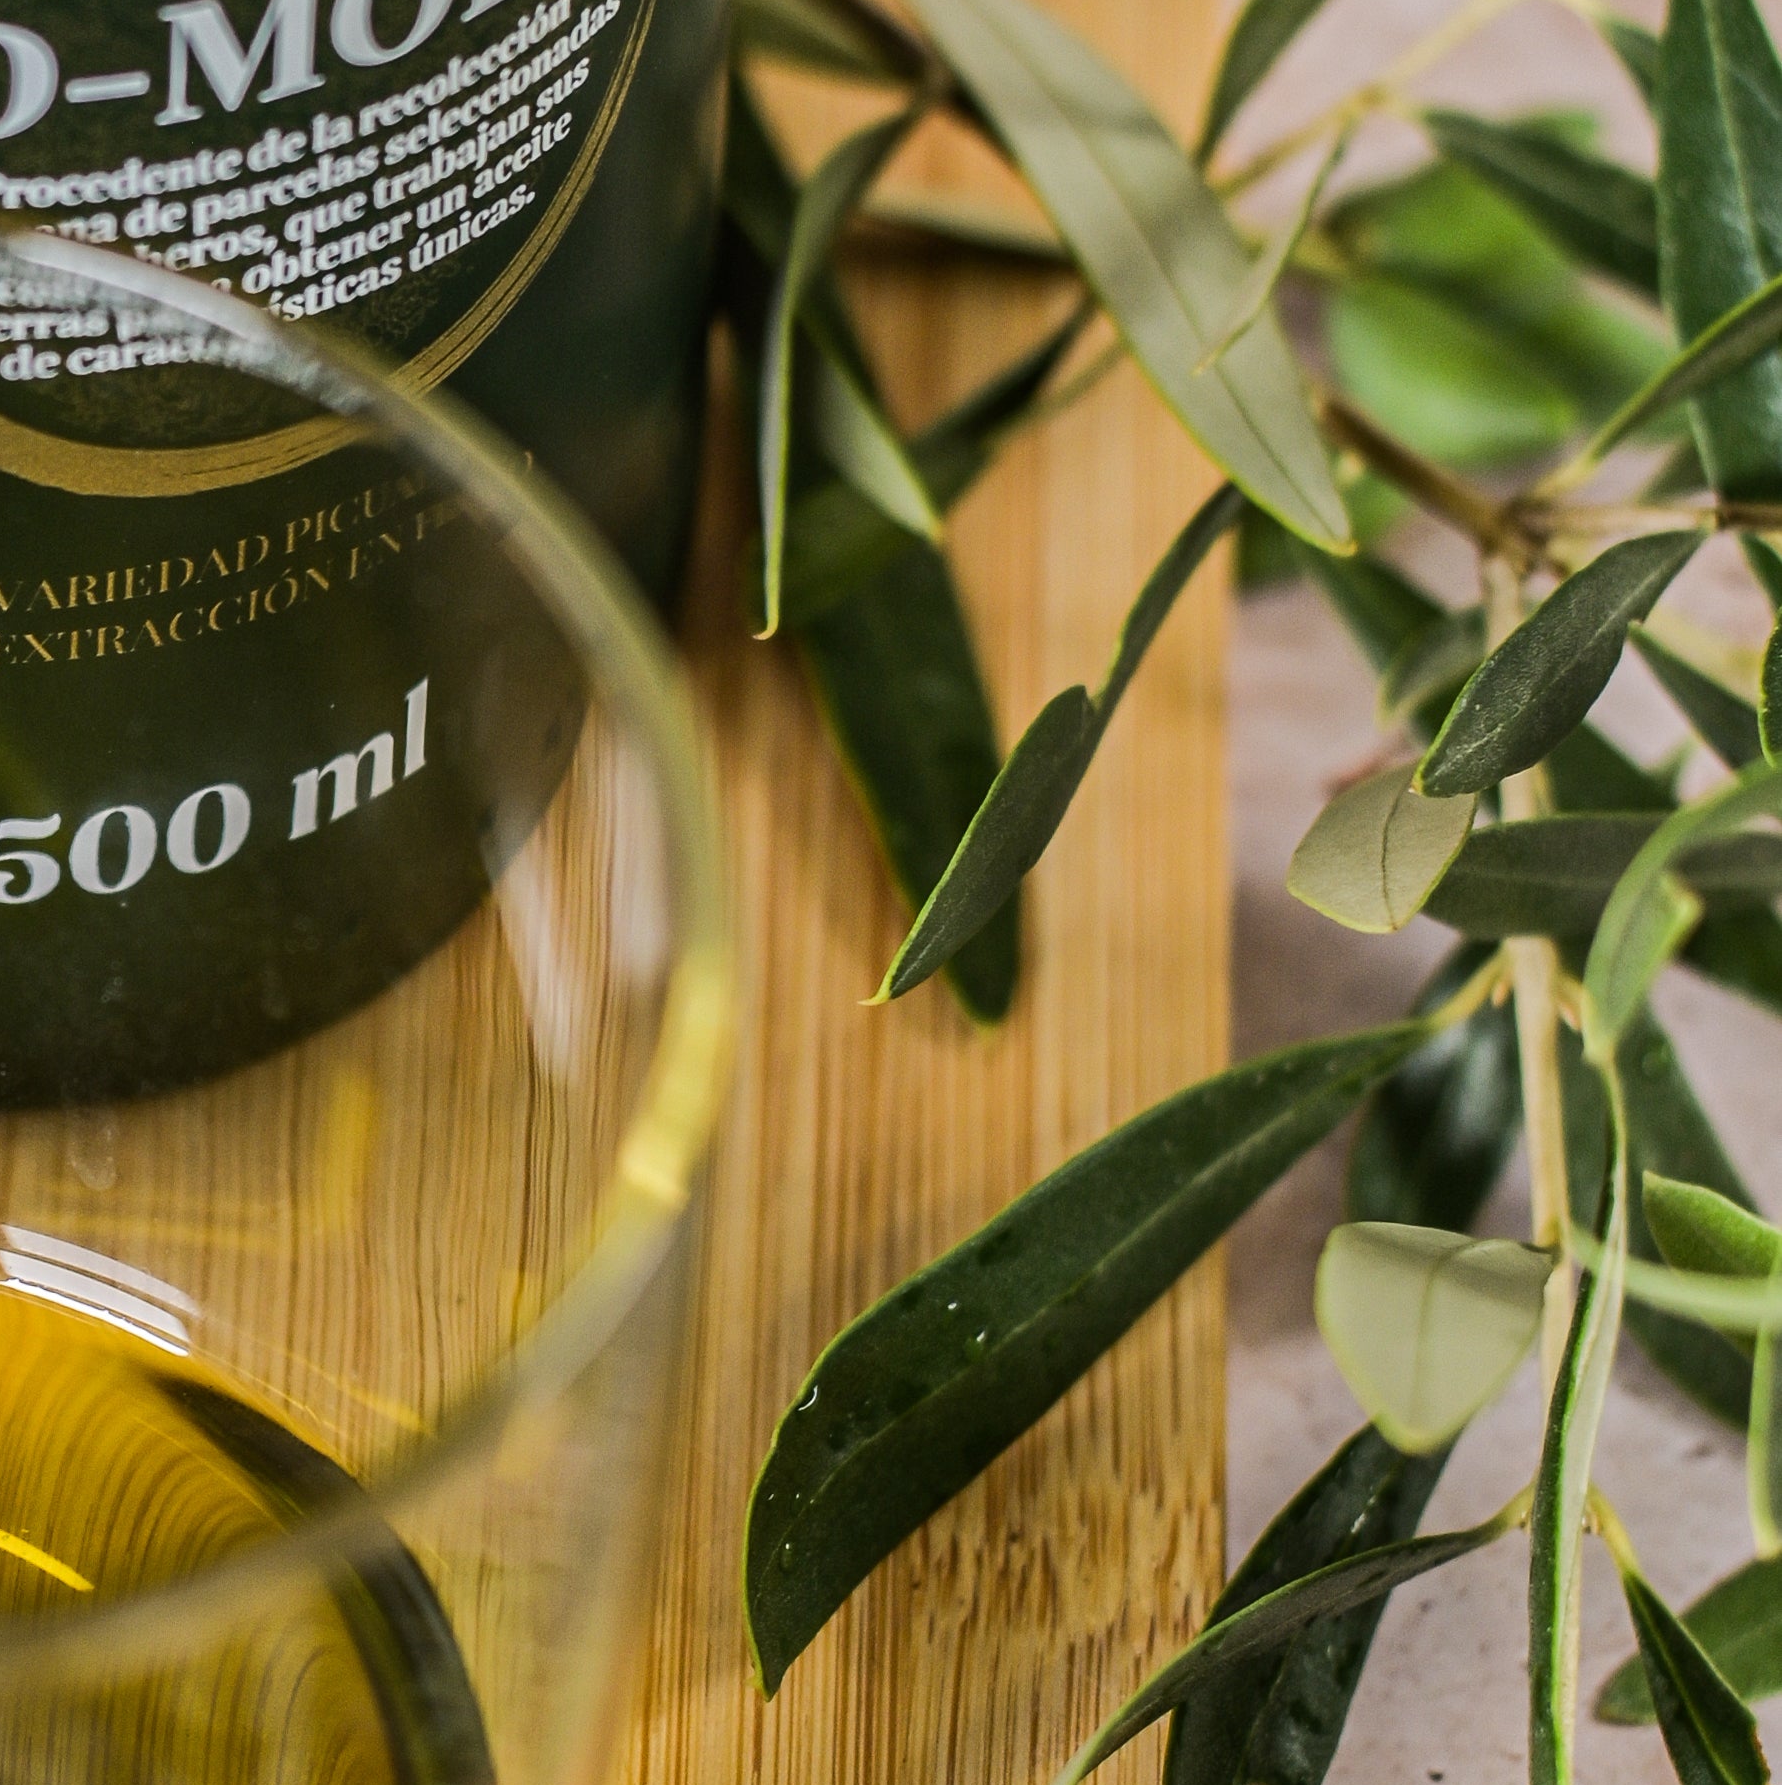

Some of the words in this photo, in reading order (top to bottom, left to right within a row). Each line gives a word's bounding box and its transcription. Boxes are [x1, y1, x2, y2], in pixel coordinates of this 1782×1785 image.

[123, 196, 187, 239] de
[191, 144, 380, 237] parcelas
[241, 209, 414, 294] obtener
[416, 183, 468, 229] un
[472, 111, 573, 198] aceite
[246, 127, 307, 172] de
[311, 112, 354, 154] la
[283, 190, 368, 247] que
[372, 104, 531, 210] trabajan
[535, 56, 591, 119] sus
[408, 183, 537, 273] únicas.
[288, 675, 430, 842] ml
